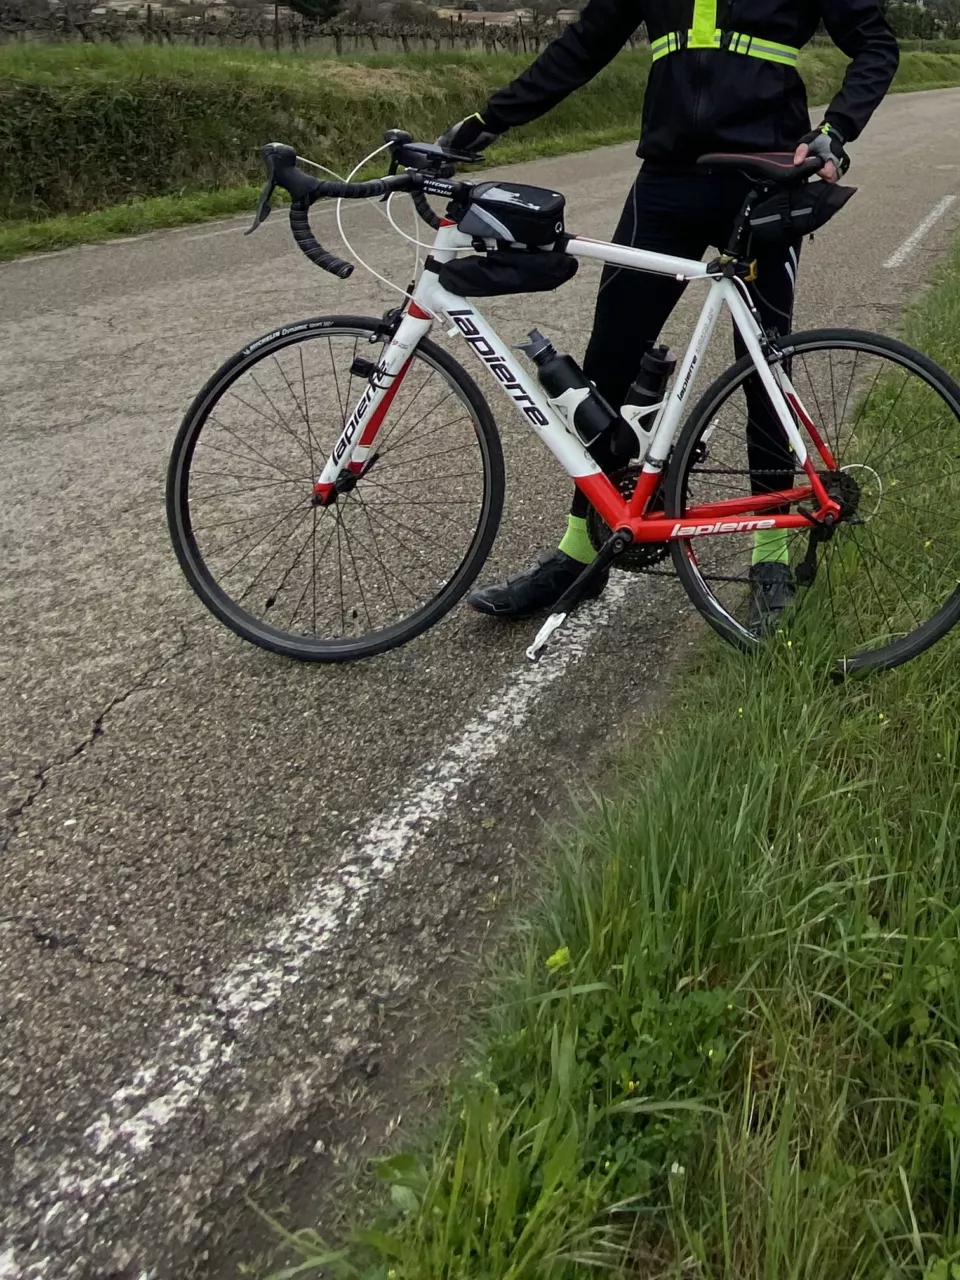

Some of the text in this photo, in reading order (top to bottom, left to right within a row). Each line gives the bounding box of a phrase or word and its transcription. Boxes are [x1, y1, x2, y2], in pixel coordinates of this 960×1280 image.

[446, 309, 550, 427] lapierre
[677, 354, 699, 402] lapierre
[670, 519, 776, 537] lapierre
